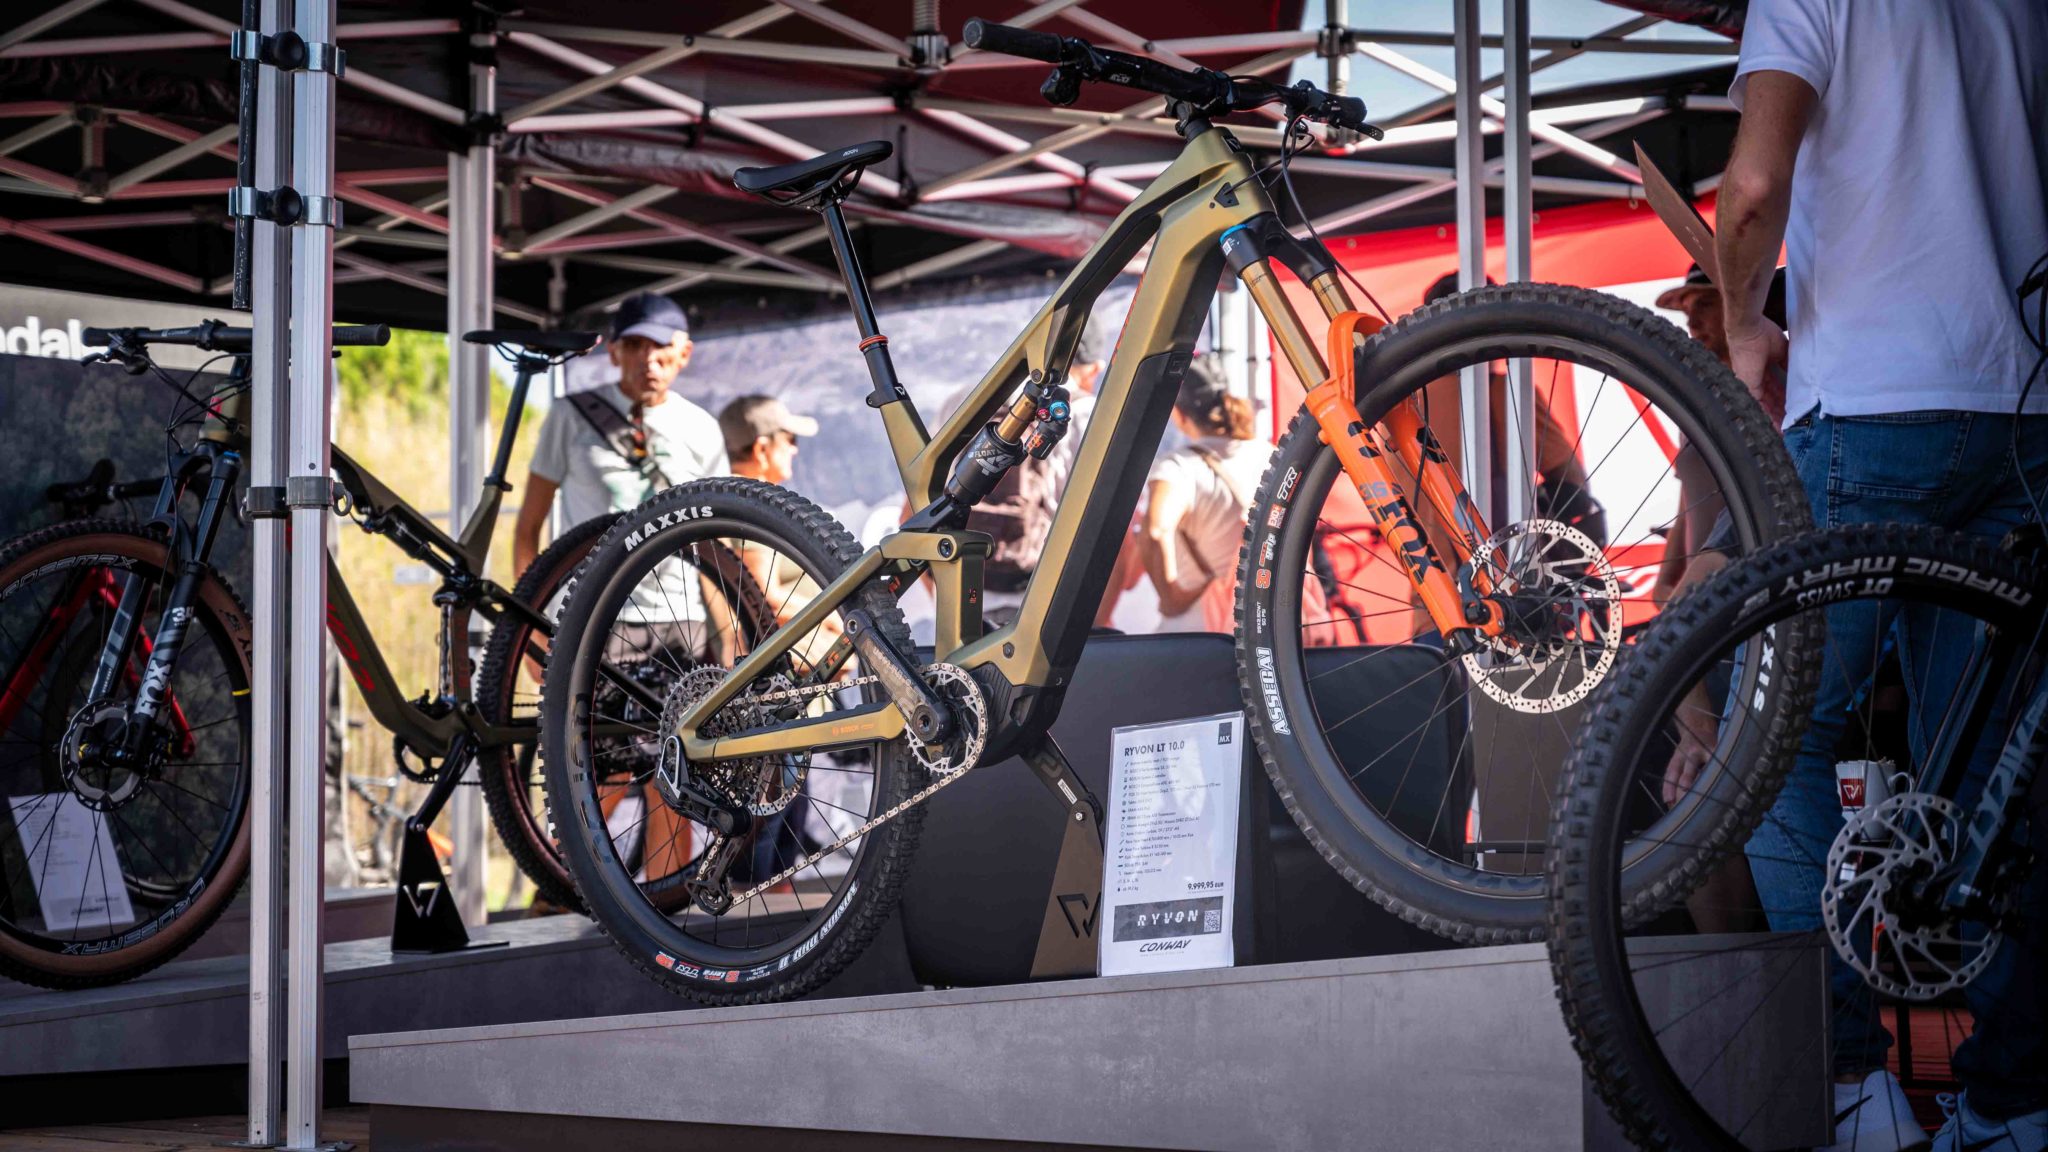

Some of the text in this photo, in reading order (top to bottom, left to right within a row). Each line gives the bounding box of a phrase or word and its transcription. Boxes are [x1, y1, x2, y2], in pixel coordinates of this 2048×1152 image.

[1277, 467, 1297, 500] TR
[624, 506, 714, 552] MAXXIS
[1377, 496, 1448, 585] FOX
[0, 554, 138, 599] ROSSMAX
[1779, 556, 2032, 607] MAGIC MARY
[1858, 577, 1894, 594] DT
[1796, 580, 1855, 609] SWISS
[134, 660, 171, 716] FOX
[1256, 647, 1291, 735] ASSEGAI
[1124, 740, 1185, 757] RYVON LT 10.0
[1218, 735, 1230, 743] MX
[1967, 720, 2040, 853] LYRIK
[1187, 881, 1214, 891] 9.999,95
[1137, 909, 1199, 927] RYVON
[1139, 939, 1192, 952] CONWAY
